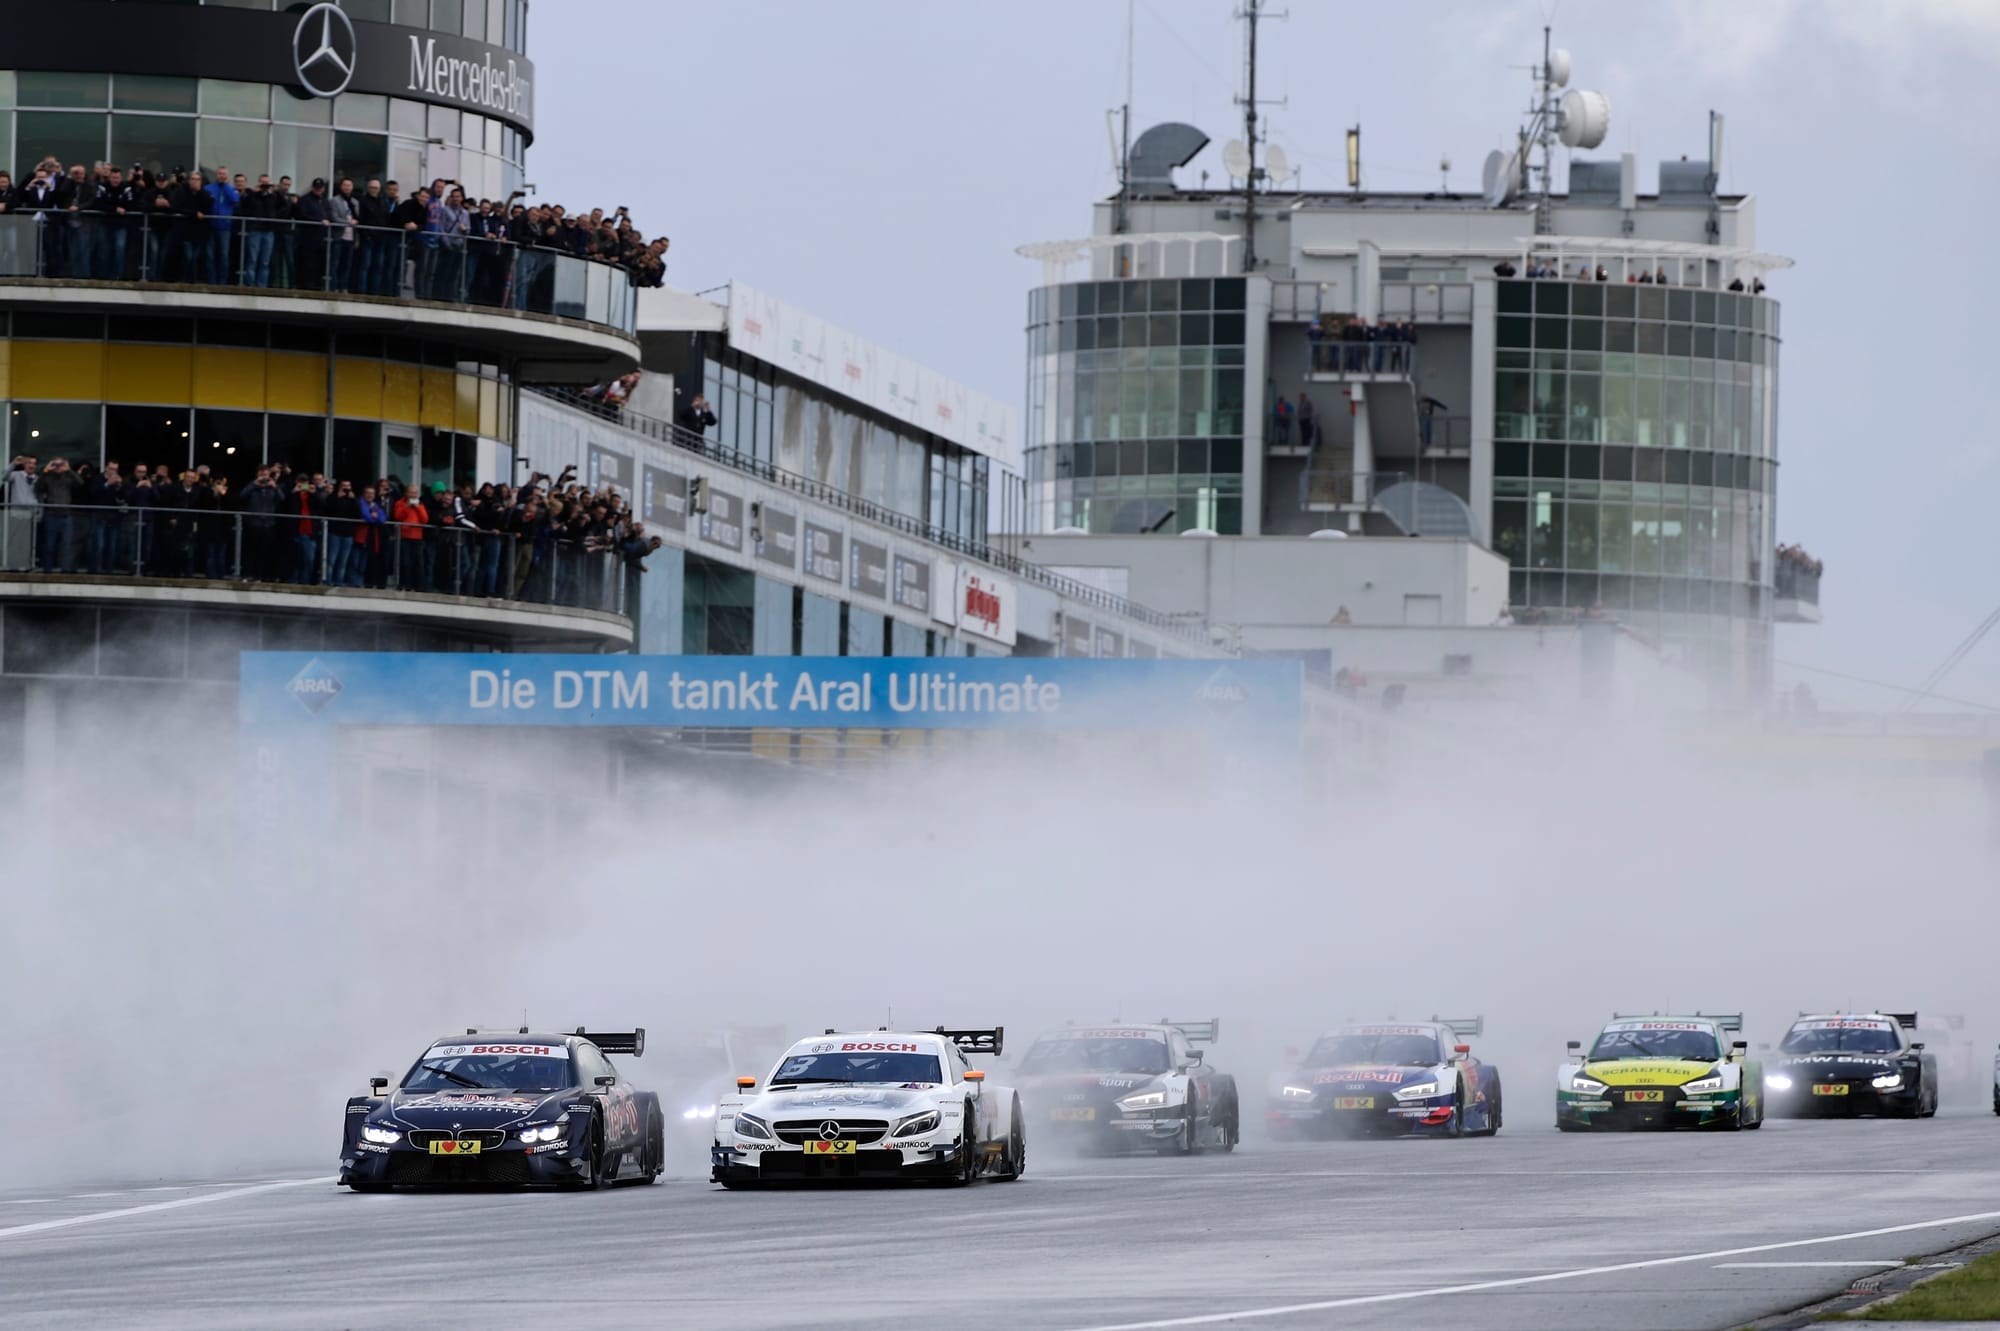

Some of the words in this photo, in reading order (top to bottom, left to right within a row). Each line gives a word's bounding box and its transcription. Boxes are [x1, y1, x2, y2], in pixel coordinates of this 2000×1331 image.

[293, 679, 337, 693] ARAL
[469, 669, 536, 709] Die
[553, 670, 649, 709] DTM
[669, 671, 779, 710] tankt
[789, 671, 871, 711] Aral
[889, 672, 1061, 711] Ultimate
[472, 1046, 549, 1055] BOSCH
[841, 1043, 917, 1052] BOSCH
[1837, 1056, 1890, 1067] Bank
[1360, 1071, 1403, 1083] Bull
[1601, 1067, 1690, 1076] SCHAEFFLER
